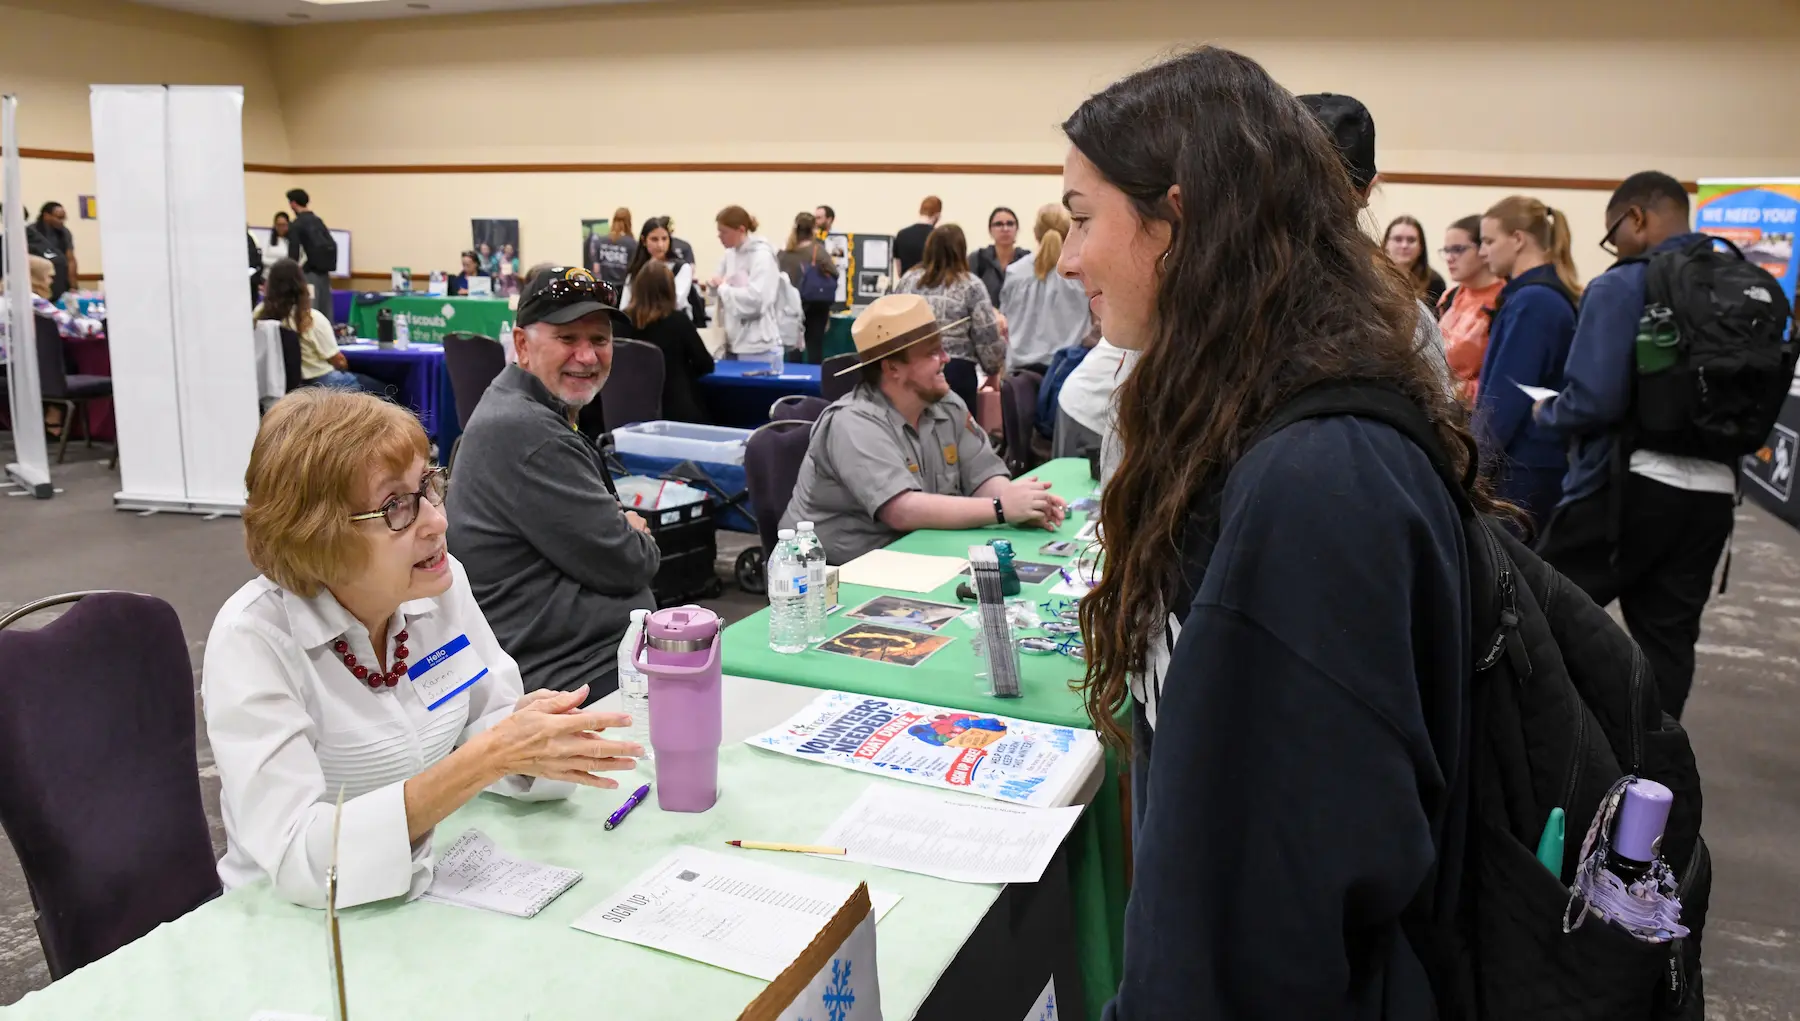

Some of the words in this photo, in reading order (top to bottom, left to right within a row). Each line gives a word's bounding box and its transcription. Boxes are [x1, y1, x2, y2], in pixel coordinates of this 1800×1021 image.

[1702, 207, 1723, 222] WE
[1724, 207, 1761, 223] NEED
[412, 314, 447, 328] scouts
[426, 649, 446, 665] Hello
[421, 670, 454, 690] Karen
[796, 699, 889, 755] VOLUNTEERS
[831, 709, 900, 754] NEEDED!
[858, 736, 882, 757] COAT
[881, 715, 912, 738] DRIVE
[991, 752, 1002, 765] HELP
[997, 742, 1008, 753] KIDS
[1003, 754, 1013, 766] KEEP
[956, 762, 971, 771] UP
[950, 769, 968, 784] SIGN
[602, 902, 638, 923] SIGN
[626, 894, 650, 906] UP
